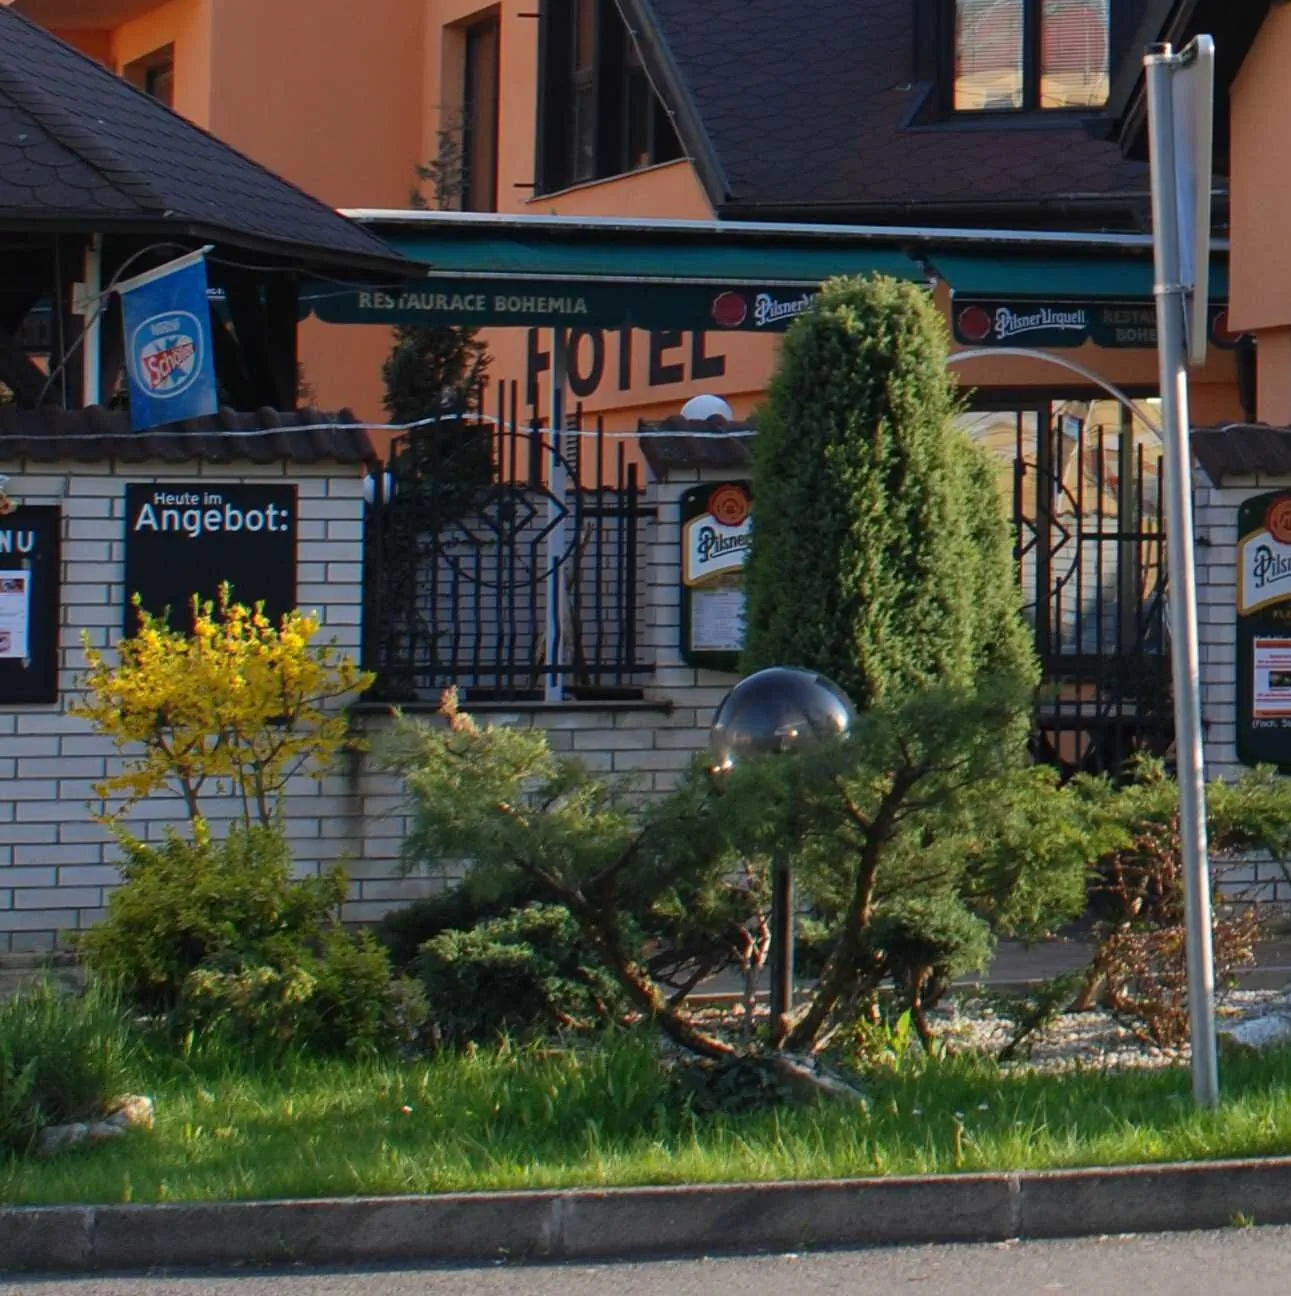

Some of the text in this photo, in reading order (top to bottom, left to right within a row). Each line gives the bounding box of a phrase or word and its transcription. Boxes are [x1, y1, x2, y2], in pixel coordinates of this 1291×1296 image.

[358, 291, 589, 314] RESTAURACE BOHEMIA
[754, 292, 804, 326] Pilsner
[994, 306, 1086, 340] Pilsner Urquell
[1115, 327, 1158, 342] BOHE
[526, 326, 727, 406] HOTEL
[153, 491, 223, 505] Heute im
[133, 503, 290, 538] Angebot:
